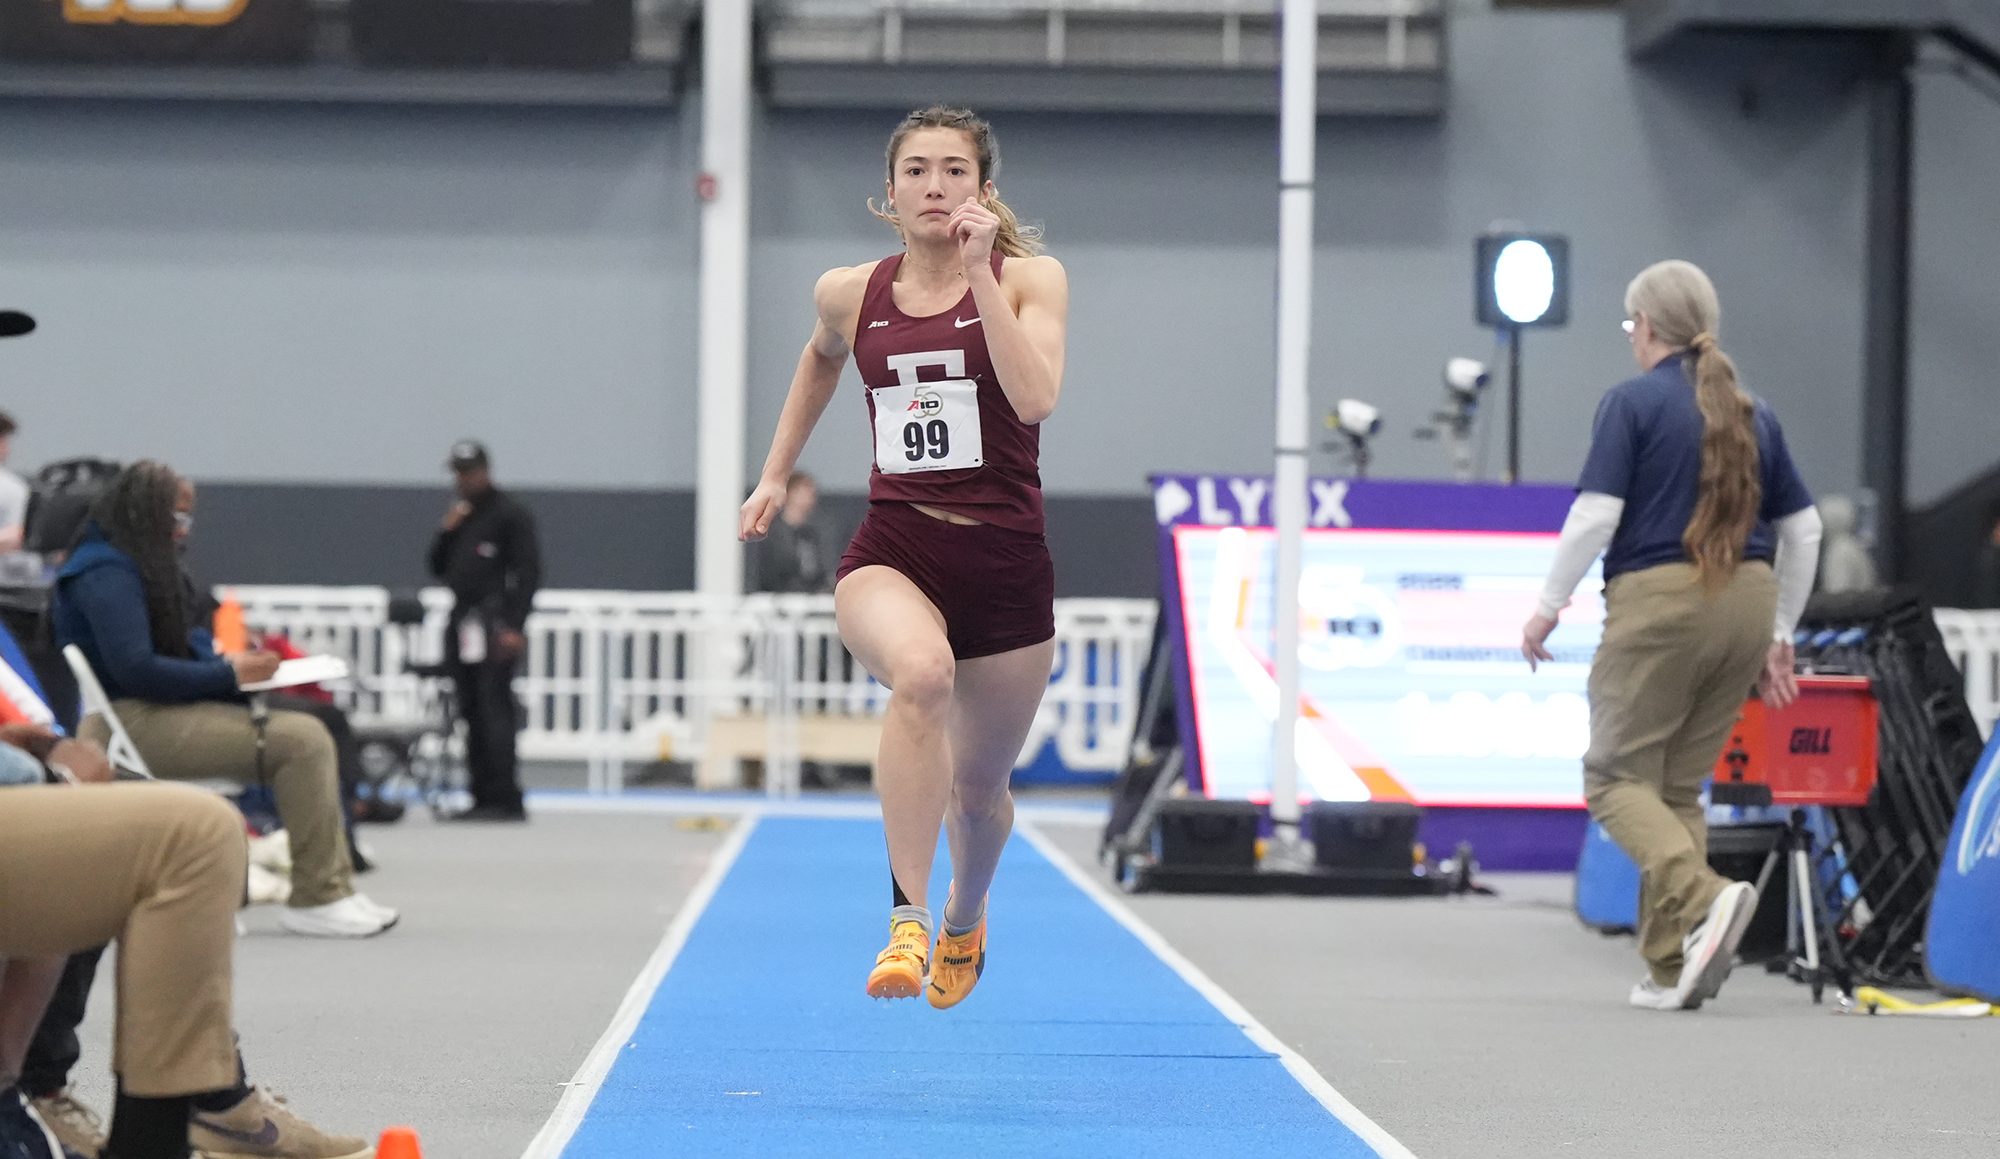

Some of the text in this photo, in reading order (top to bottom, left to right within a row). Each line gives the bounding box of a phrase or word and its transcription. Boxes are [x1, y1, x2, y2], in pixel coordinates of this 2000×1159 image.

[868, 320, 889, 329] A10
[906, 400, 940, 412] A10
[903, 419, 950, 462] 99
[1197, 477, 1352, 528] LYX
[1789, 727, 1831, 754] GILL
[943, 956, 973, 965] PUMA
